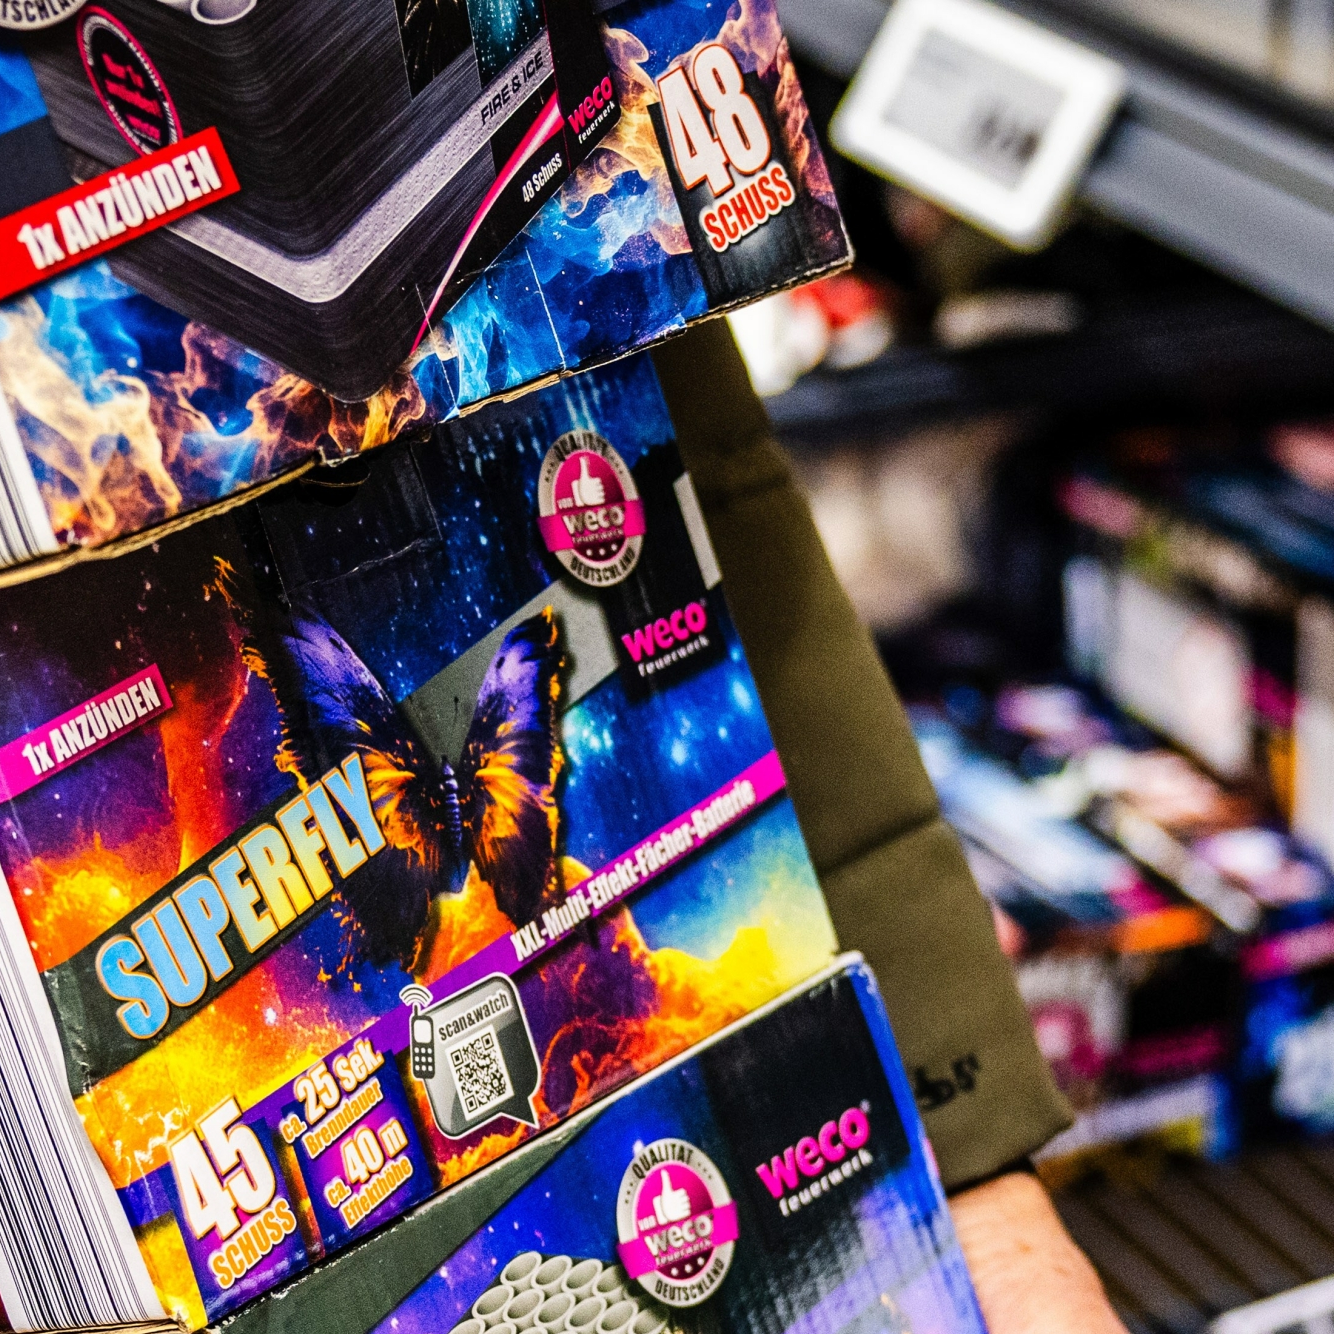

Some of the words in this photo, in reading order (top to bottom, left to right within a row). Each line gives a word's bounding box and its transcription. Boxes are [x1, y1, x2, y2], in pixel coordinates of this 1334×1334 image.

[480, 87, 510, 126] FIRE
[511, 74, 524, 94] &
[522, 50, 545, 82] ICE
[568, 76, 613, 135] weco
[578, 101, 616, 145] feuerwerk
[658, 42, 772, 198] 48
[17, 223, 65, 270] 1x
[56, 145, 222, 255] ANZÜNDEN
[521, 180, 535, 203] 48
[532, 152, 563, 194] Schuss
[702, 167, 796, 252] SCHUSS
[562, 505, 625, 535] weco
[621, 602, 707, 663] weco
[637, 634, 710, 678] feuerwerk
[21, 742, 56, 777] 1x
[48, 677, 162, 764] ANZÜNDEN
[95, 752, 387, 1040] SUPERFLY
[509, 779, 756, 962] XXL-Multi-Effekt-Fächer-Batterie
[438, 992, 510, 1041] scan&watch
[279, 1111, 308, 1143] ca.
[294, 1060, 341, 1125] 25
[333, 1038, 385, 1093] Sek.
[302, 1079, 384, 1160] Brenndauer
[168, 1096, 276, 1241] 45
[323, 1177, 351, 1209] ca.
[342, 1127, 385, 1185] 40
[378, 1119, 409, 1159] m
[755, 1104, 870, 1199] weco
[779, 1148, 873, 1218] feuerwerk
[339, 1156, 414, 1229] Effekthöhe
[208, 1198, 297, 1290] SCHUSS
[644, 1214, 714, 1258] weco
[654, 1258, 726, 1303] DEUTSCHLAND
